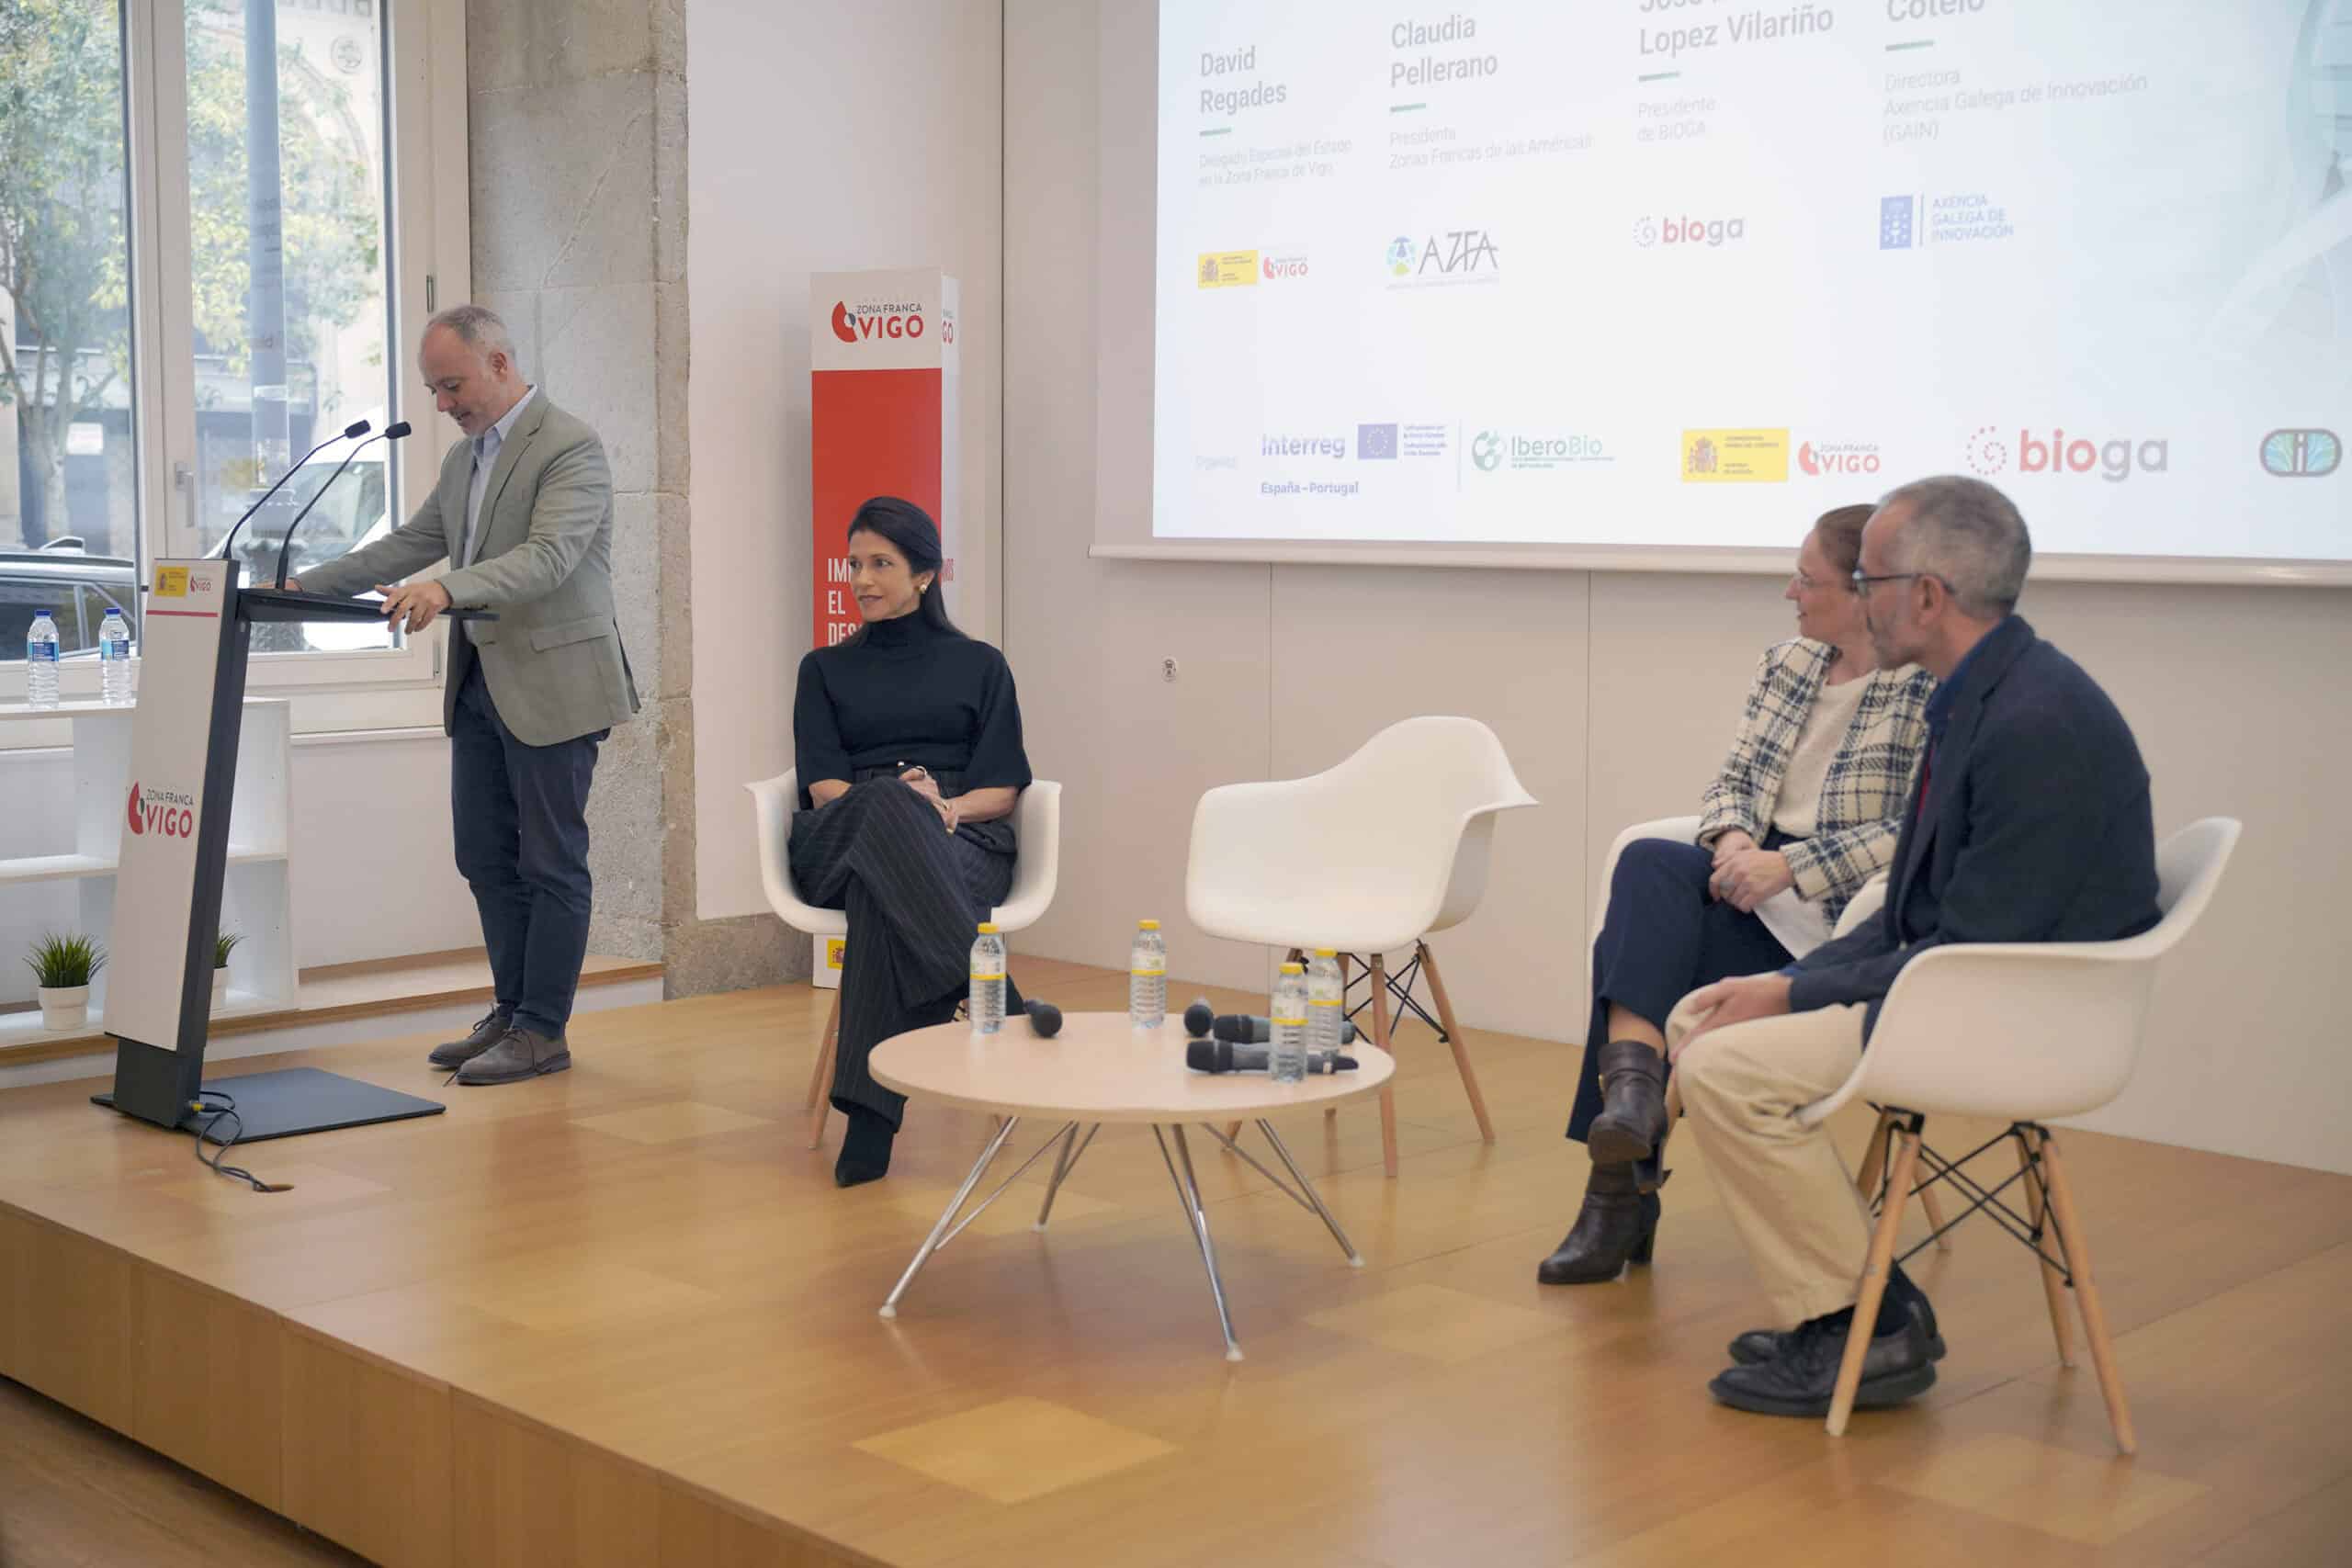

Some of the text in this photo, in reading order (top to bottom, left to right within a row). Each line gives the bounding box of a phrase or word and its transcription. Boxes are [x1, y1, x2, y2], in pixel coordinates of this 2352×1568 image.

[1391, 15, 1476, 48] Claudia
[1640, 3, 1834, 58] Lopez Vilariño
[1201, 45, 1257, 76] David
[1391, 54, 1498, 87] Pellerano
[1885, 69, 1961, 93] Directora
[1200, 81, 1287, 116] Regades
[1884, 73, 2148, 117] Axencia Galega de Innovación
[1637, 125, 1655, 141] de
[1883, 119, 1939, 142] (GAIN)
[1932, 195, 1987, 209] AXENCIA
[1988, 208, 2006, 221] DE
[1662, 216, 1744, 247] bioga
[1277, 262, 1308, 276] VIGO
[856, 302, 922, 314] ZONA FRANCA
[858, 314, 923, 339] VIGO
[1261, 434, 1345, 459] Interreg
[1512, 434, 1602, 456] IberoBio
[2019, 428, 2167, 483] bioga
[1822, 454, 1880, 474] VIGO
[828, 590, 846, 615] EL
[164, 791, 194, 807] FRANCA
[146, 803, 193, 838] VIGO
